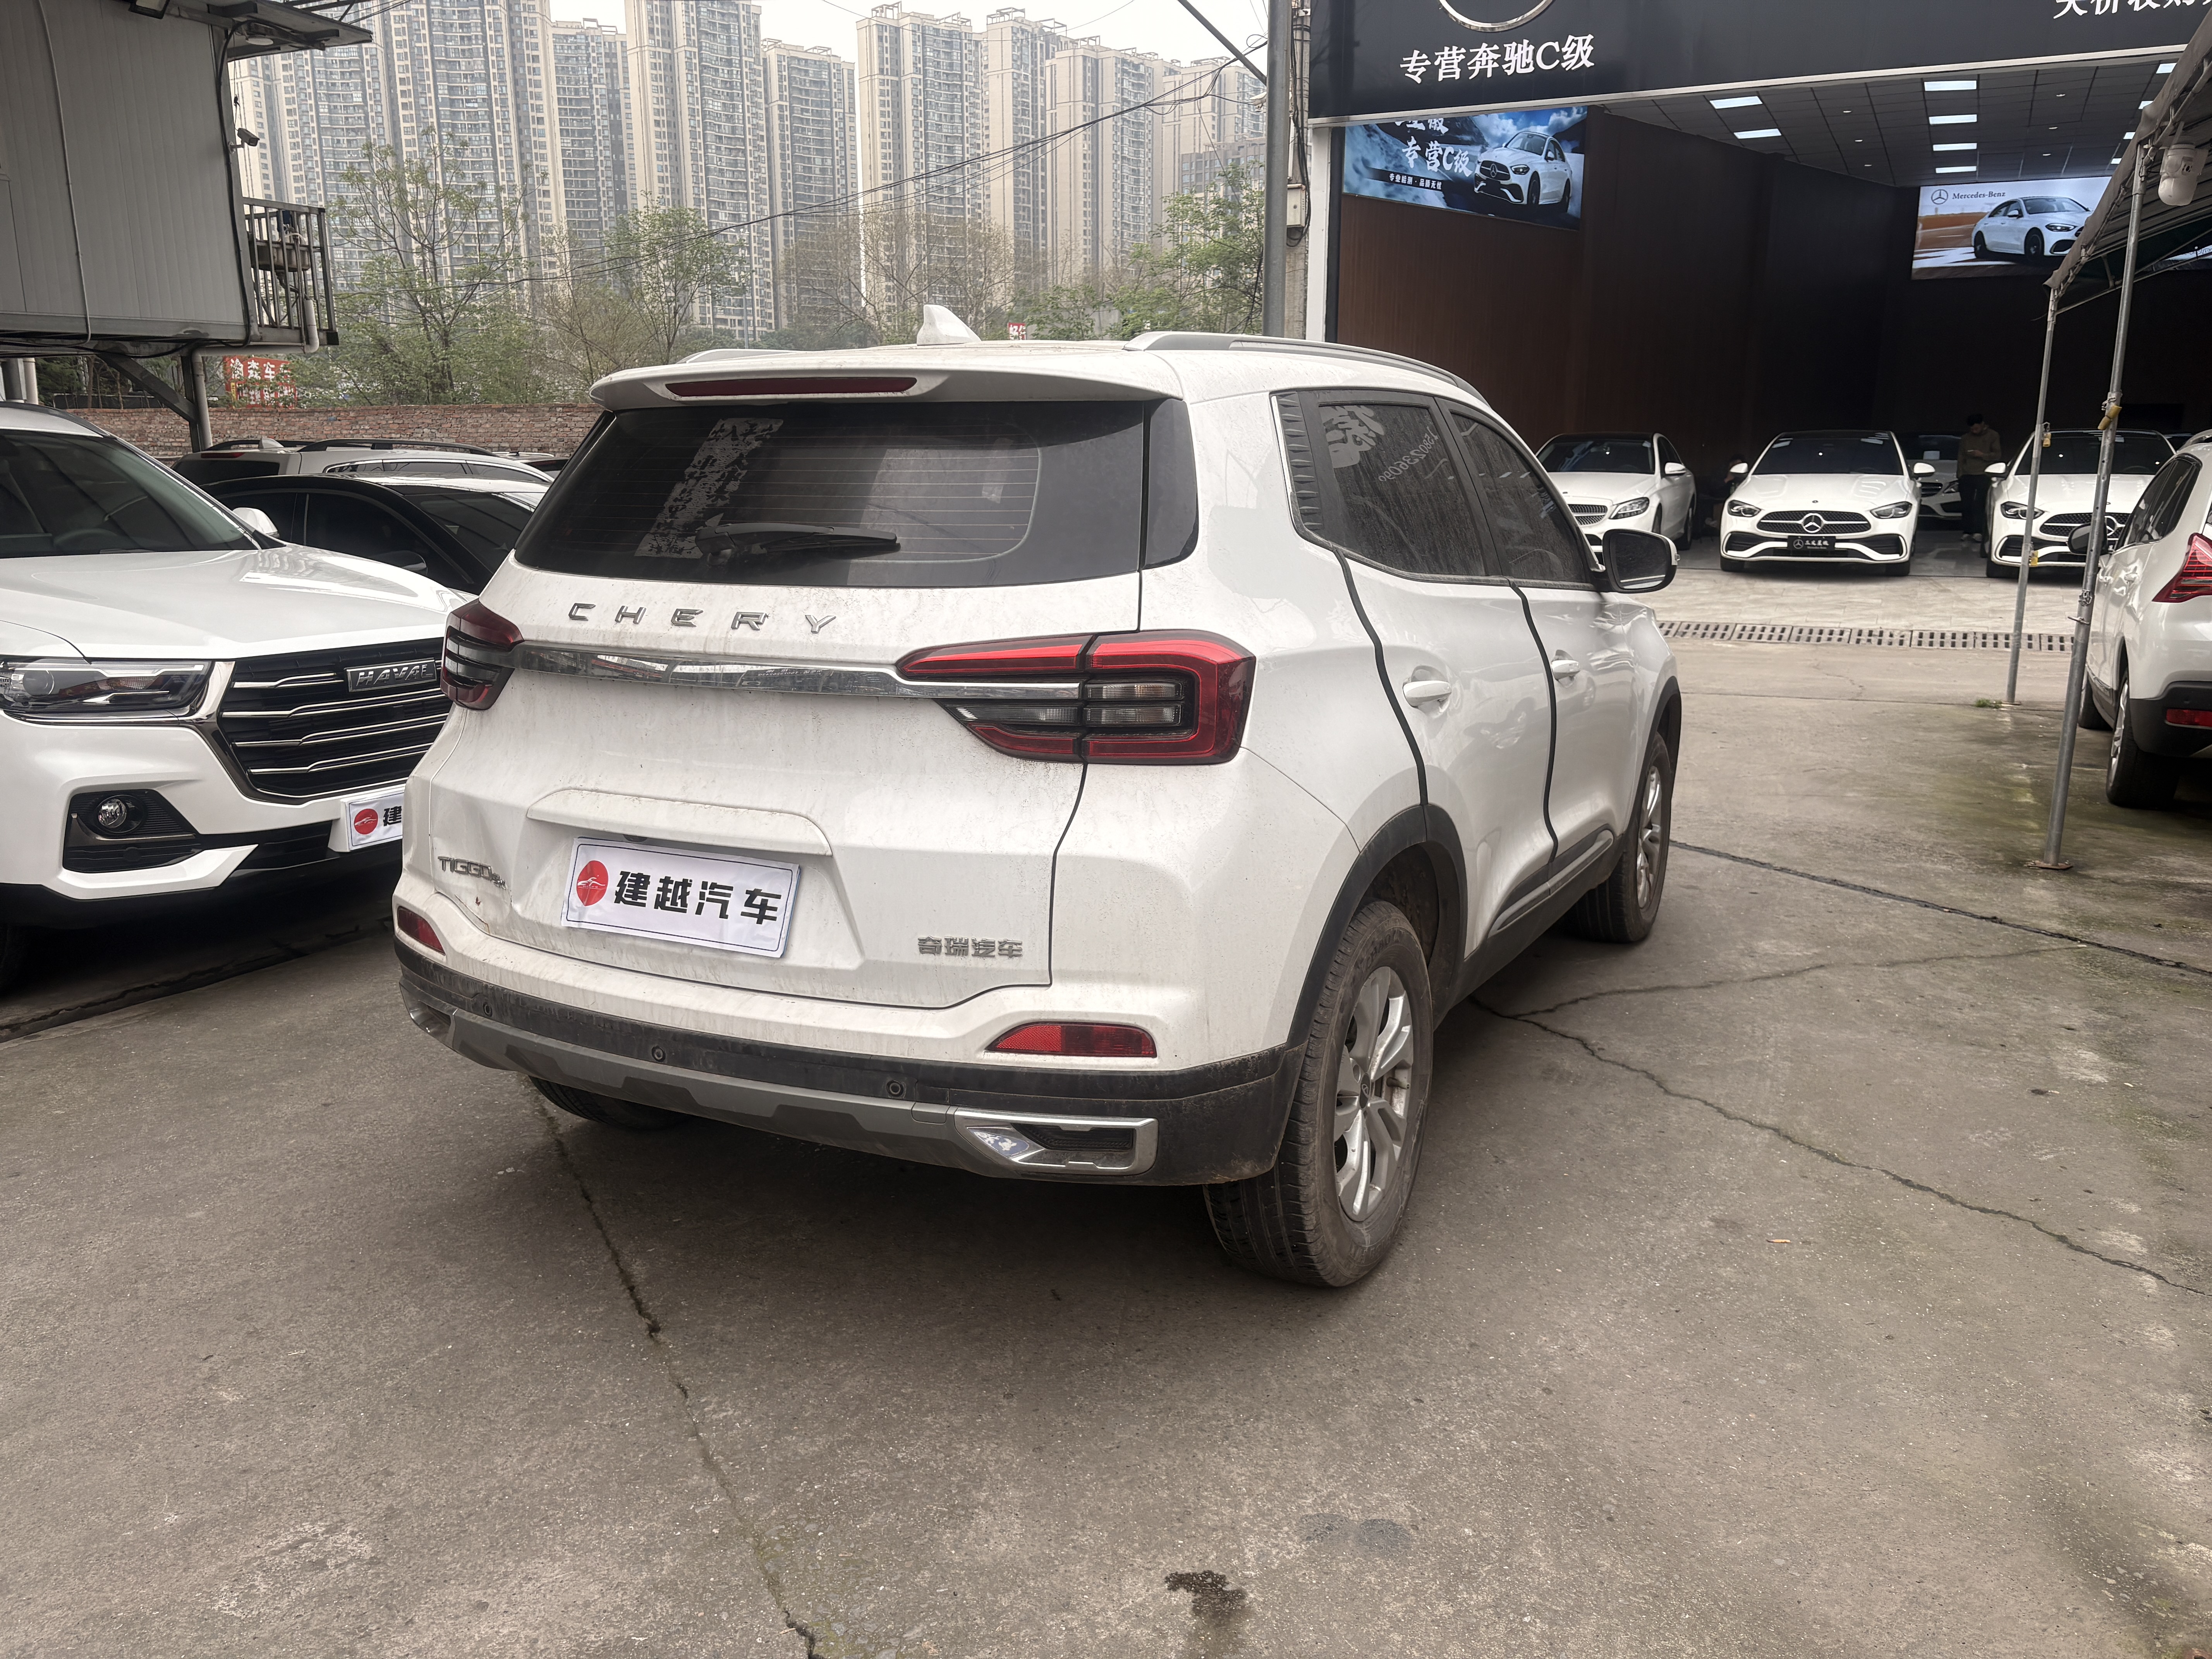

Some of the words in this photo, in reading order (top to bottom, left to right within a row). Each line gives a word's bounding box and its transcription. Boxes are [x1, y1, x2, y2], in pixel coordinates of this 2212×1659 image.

[1400, 34, 1595, 84] 专营奔驰C级
[1402, 136, 1473, 177] 专营C级
[1952, 191, 2006, 199] Mercedes-Benz
[568, 603, 837, 634] CHERY
[356, 664, 433, 687] HAVAL
[614, 871, 782, 925] 建越汽车
[917, 935, 1023, 958] 奇瑞汽车
